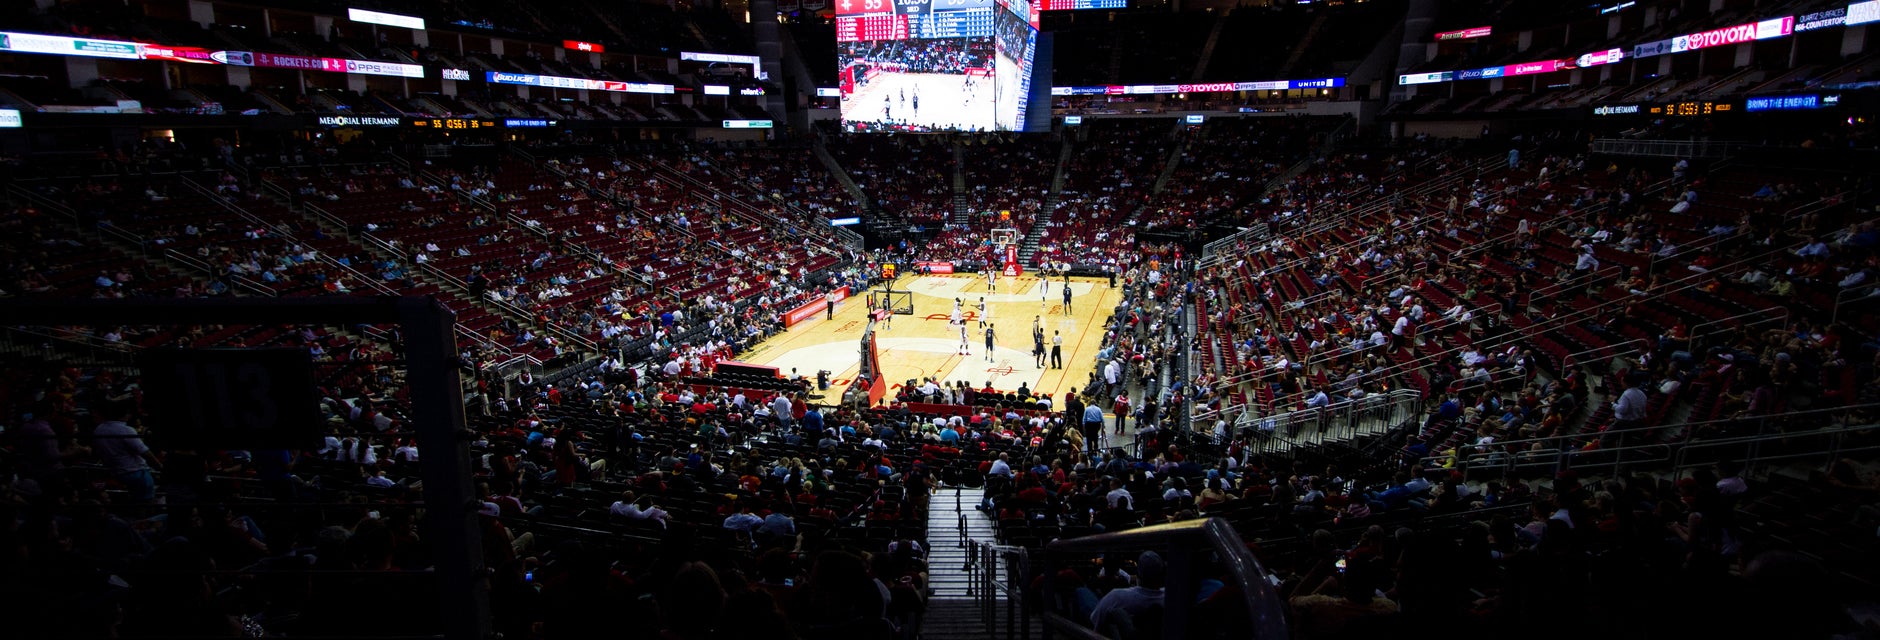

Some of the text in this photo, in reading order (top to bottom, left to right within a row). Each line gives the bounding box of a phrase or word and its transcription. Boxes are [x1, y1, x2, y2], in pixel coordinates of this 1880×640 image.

[1703, 24, 1756, 47] TOYOTA
[273, 56, 329, 70] ROCKETS.COM
[358, 64, 381, 73] PPS
[497, 73, 535, 83] BUD LIGHT
[1462, 70, 1480, 78] BUD
[1192, 83, 1234, 92] TOYOTA
[1704, 103, 1712, 114] 35
[1747, 99, 1768, 109] BRING
[1769, 99, 1782, 108] THE
[1666, 104, 1675, 115] 55
[319, 116, 399, 126] MEMORIAL HERMANN
[433, 119, 442, 128] 55
[471, 120, 479, 128] 35
[175, 361, 279, 430] 113
